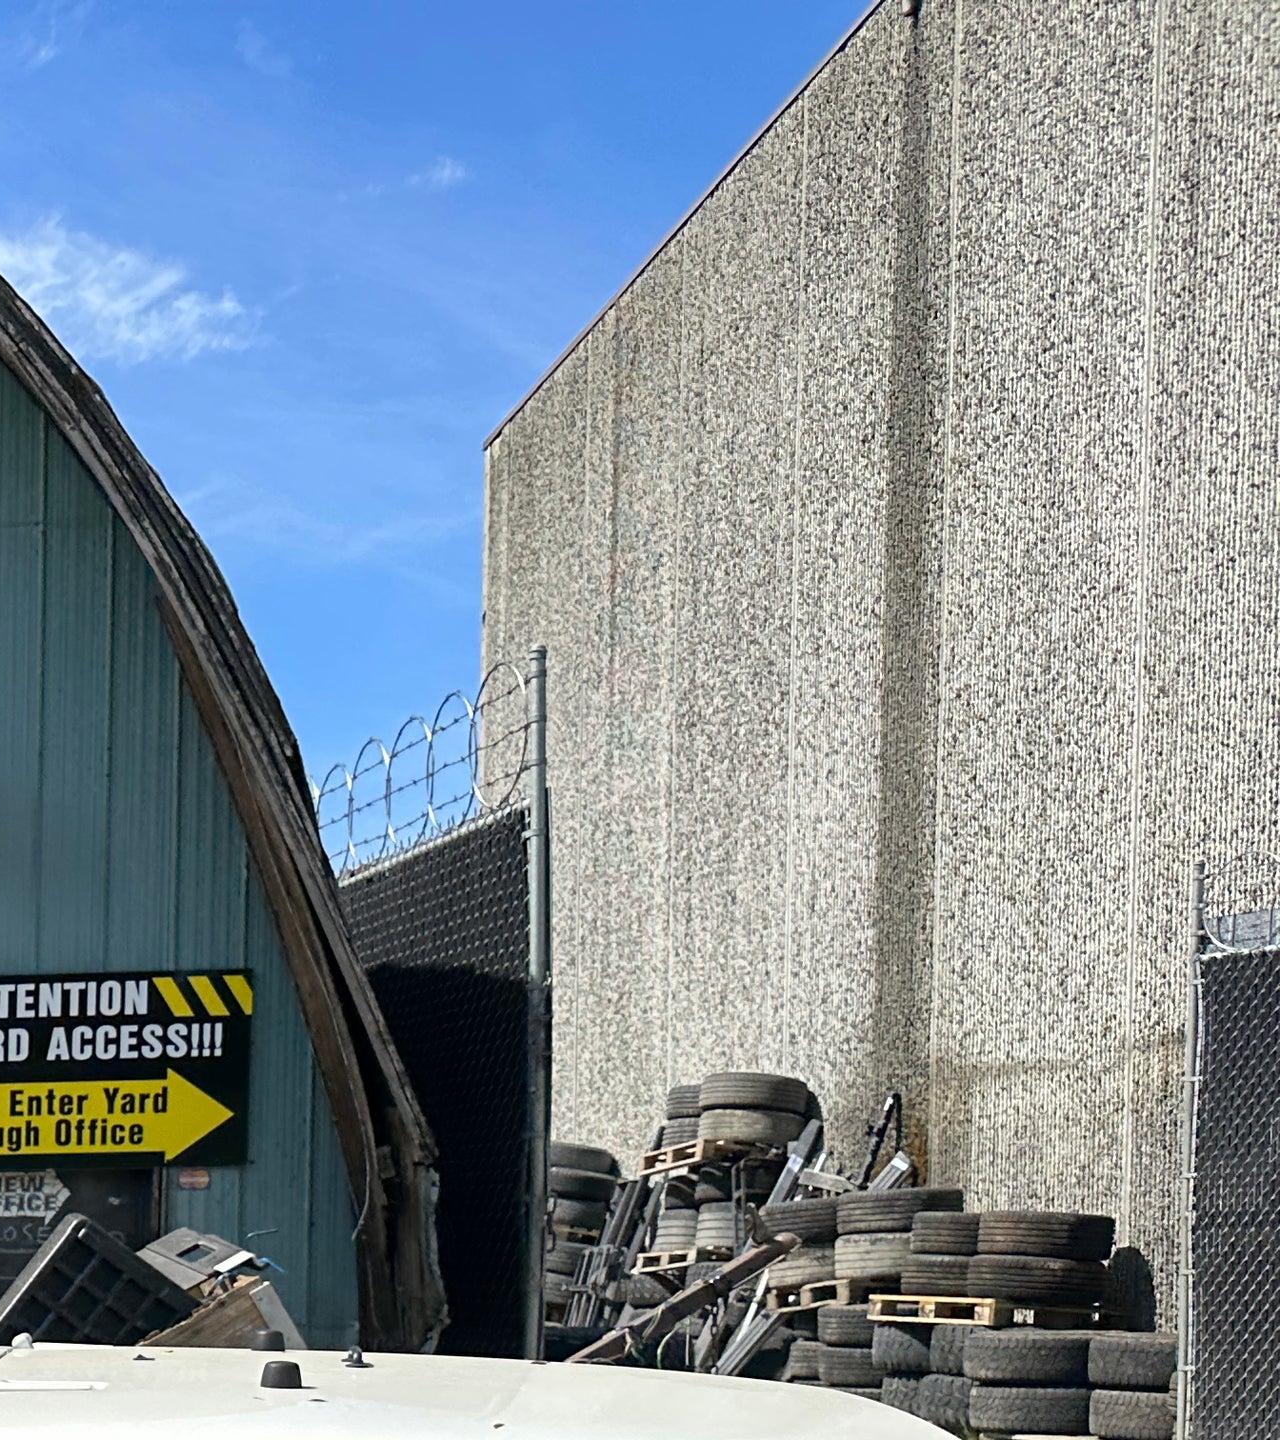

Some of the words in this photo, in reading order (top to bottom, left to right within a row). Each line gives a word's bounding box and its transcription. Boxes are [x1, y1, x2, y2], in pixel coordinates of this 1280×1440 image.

[46, 1022, 224, 1061] ACCESS!!!
[9, 1089, 89, 1117] Enter
[103, 1086, 169, 1114] Yard
[54, 1118, 144, 1147] Office
